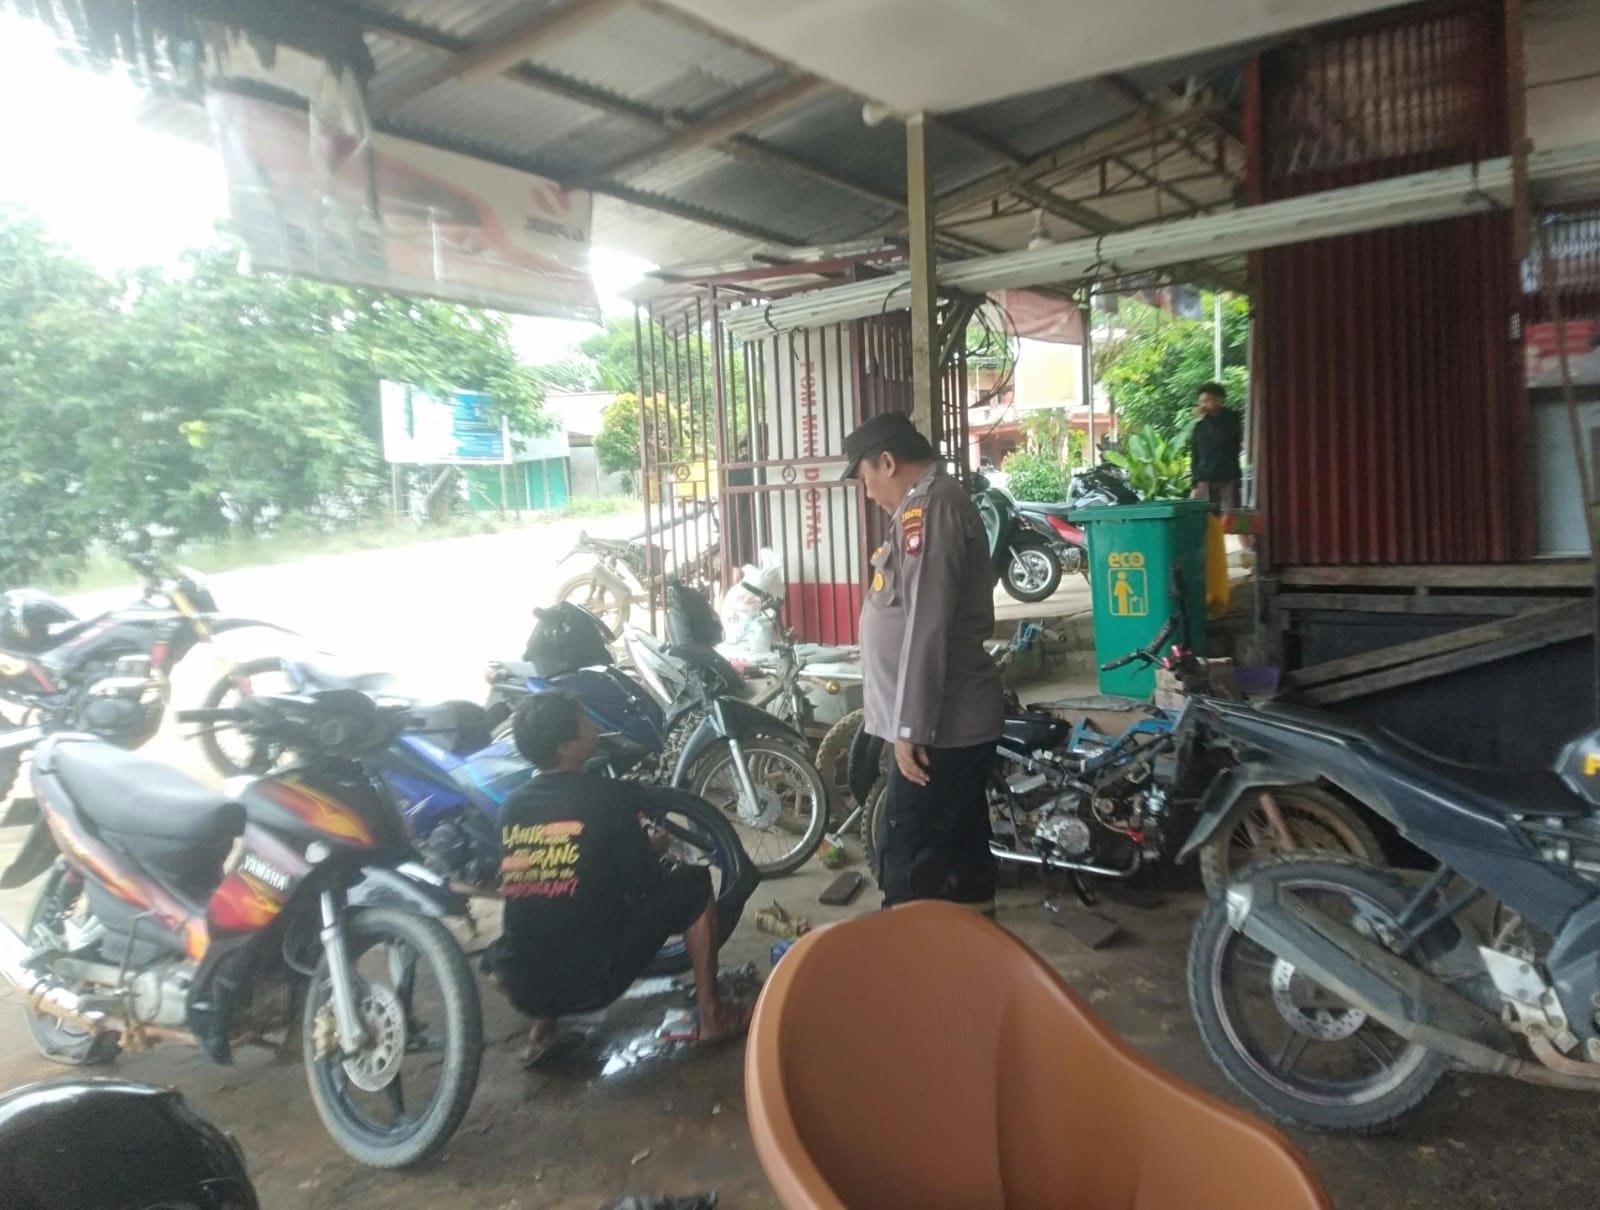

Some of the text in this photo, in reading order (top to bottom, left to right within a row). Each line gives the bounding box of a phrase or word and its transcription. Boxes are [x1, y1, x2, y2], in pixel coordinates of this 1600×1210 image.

[800, 361, 822, 550] POM MIN DGITAL
[1108, 551, 1146, 569] eco
[243, 854, 290, 891] YAMAHA
